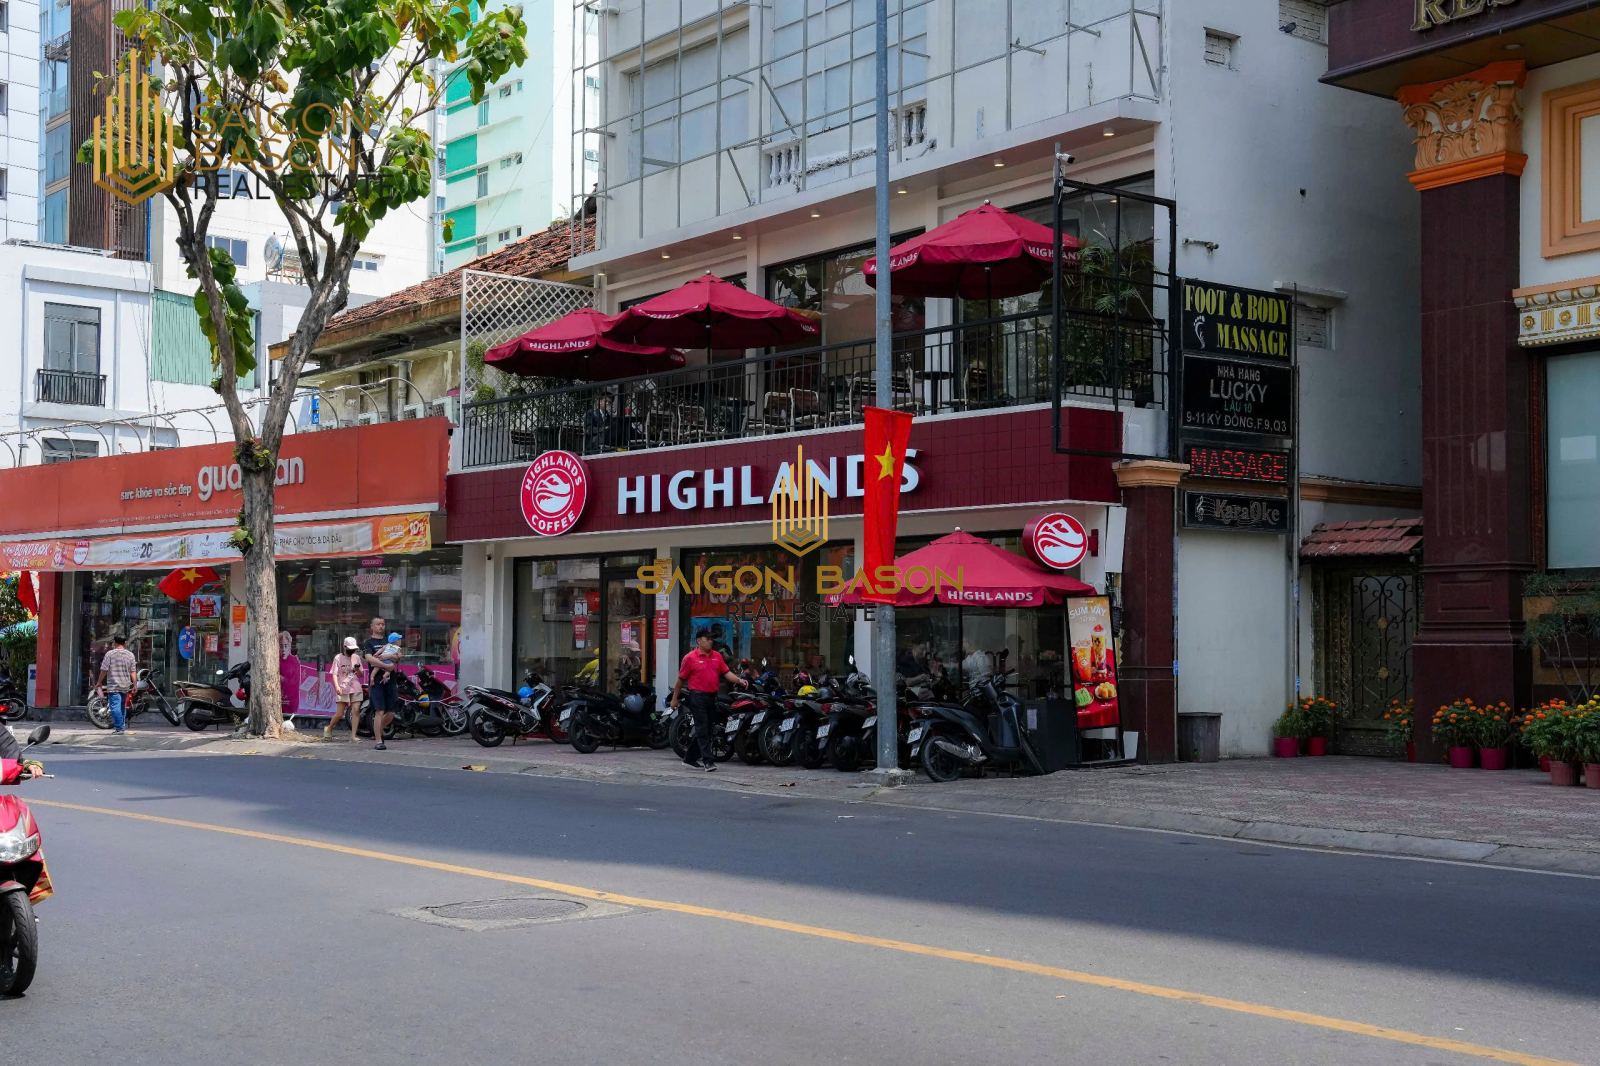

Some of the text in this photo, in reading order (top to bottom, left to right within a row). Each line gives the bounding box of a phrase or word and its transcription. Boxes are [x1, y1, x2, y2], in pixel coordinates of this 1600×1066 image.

[1184, 284, 1289, 325] FOOT & BODY
[529, 340, 591, 350] HIGHLANDS
[1216, 322, 1289, 357] MASSAGE
[1209, 379, 1268, 403] LUCKY
[198, 456, 305, 502] guaan
[525, 455, 583, 491] HIGHLANDS
[1191, 447, 1285, 480] MASSAGE
[531, 509, 576, 532] COFFEE
[947, 590, 1034, 602] HIGHLANDS
